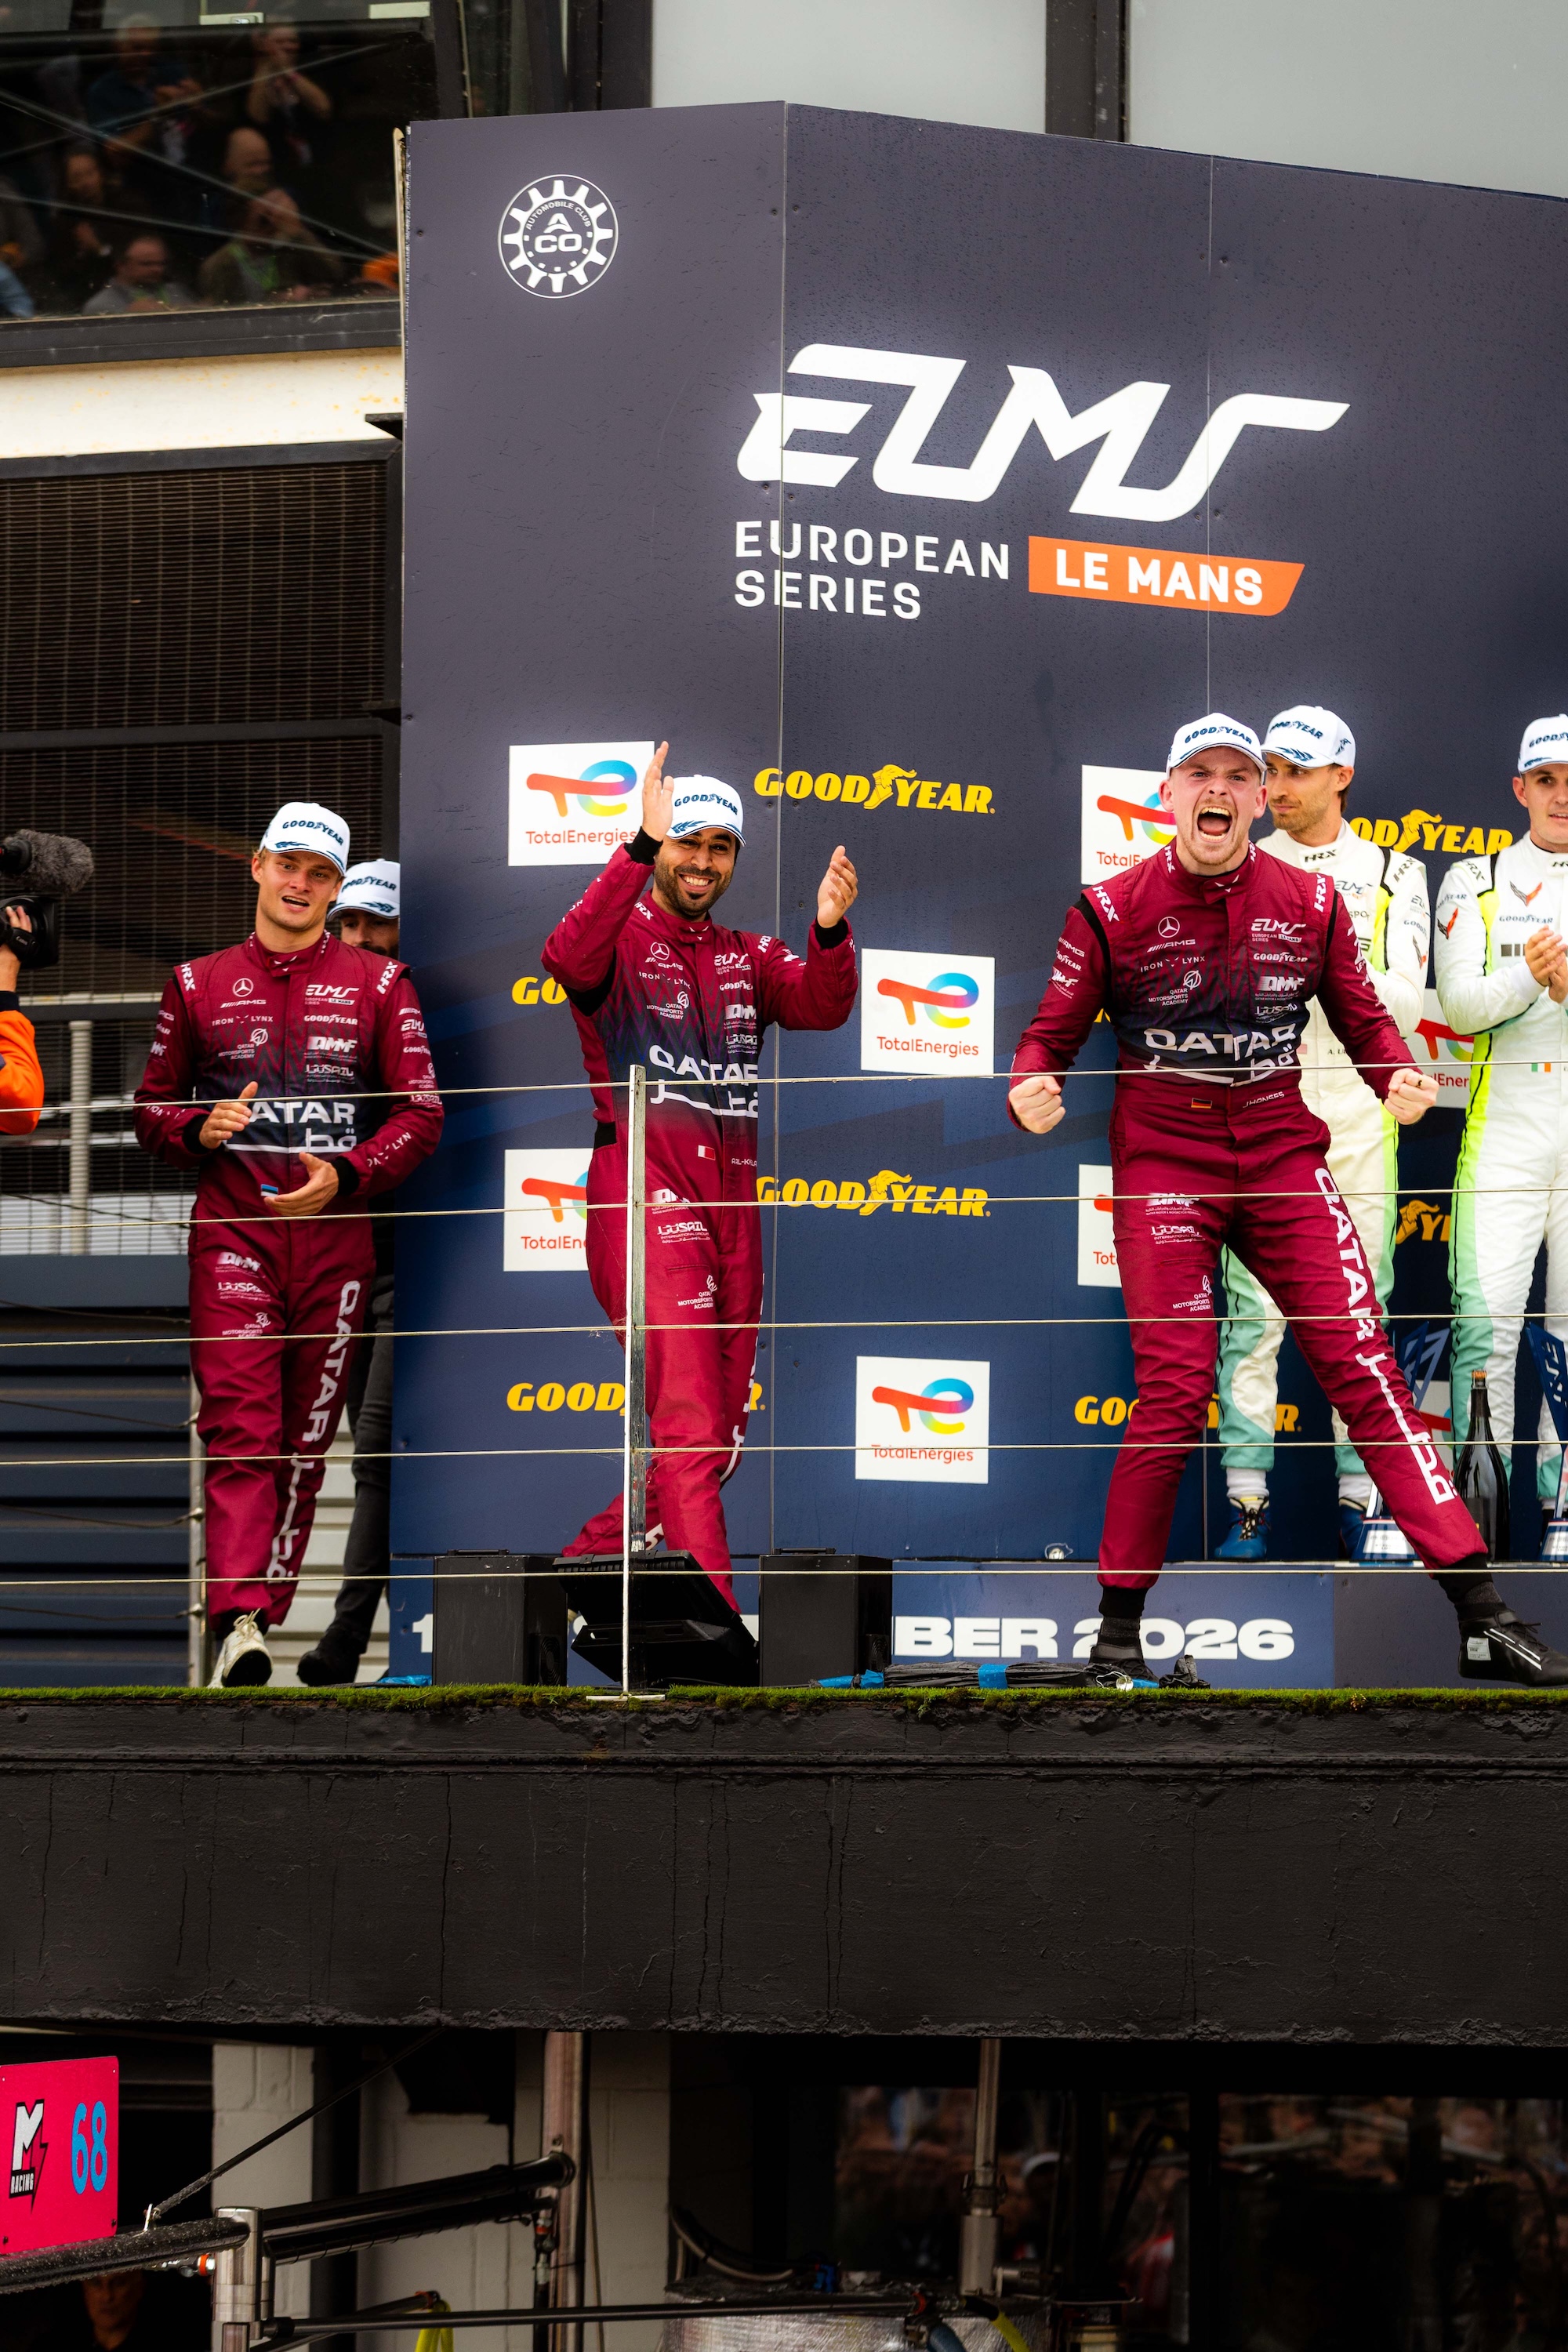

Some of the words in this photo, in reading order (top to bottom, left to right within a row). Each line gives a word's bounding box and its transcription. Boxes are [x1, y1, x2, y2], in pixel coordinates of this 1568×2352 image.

[525, 201, 575, 230] AUTOMOBILE
[575, 206, 592, 227] CLUB
[737, 343, 1350, 522] ELMS
[735, 521, 1011, 580] EUROPEAN
[1055, 547, 1109, 591] LE
[1127, 557, 1264, 607] MANS
[734, 569, 921, 621] SERIES
[1184, 725, 1253, 745] GOODYEAR
[1529, 731, 1568, 748] GOOD
[754, 764, 994, 815] GOODYEAR
[674, 793, 739, 815] GOODYEAR
[282, 820, 344, 846] GOODYEAR
[525, 828, 637, 847] TotalEnergies
[1348, 809, 1513, 855] ODYEAR
[1305, 849, 1338, 863] HRX
[1393, 858, 1417, 883] HRX
[1092, 885, 1120, 922] HRX
[1250, 918, 1306, 935] ELMS
[757, 935, 772, 953] HR
[1065, 941, 1085, 958] AMG
[1164, 939, 1196, 949] AMG
[658, 962, 684, 971] AMG
[1140, 961, 1163, 973] IRON
[1182, 956, 1206, 965] LYNX
[1254, 952, 1308, 963] GOODYEAR
[180, 963, 196, 992] HRX
[376, 961, 398, 994] HRX
[305, 984, 360, 998] ELMS
[1148, 993, 1189, 1004] MOTORSPORTS
[304, 1014, 358, 1025] GOODYEAR
[647, 1005, 684, 1015] MOTORSPORTS
[725, 1004, 757, 1020] QMM
[212, 1018, 234, 1026] IRON
[877, 1036, 979, 1058] TotalEnergies
[1144, 1023, 1296, 1061] QATAR
[249, 1101, 356, 1125] ATAR
[392, 1132, 413, 1150] LYN
[757, 1170, 987, 1217] GOODYEAR
[521, 1235, 587, 1250] TotalEn
[217, 1251, 261, 1272] QMM
[1314, 1167, 1377, 1342] QATAR
[677, 1297, 713, 1307] MOTORSPORTS
[1173, 1299, 1210, 1309] MOTORSPORTS
[302, 1279, 361, 1443] QATAR
[871, 1444, 974, 1465] TotalEnergies
[71, 2100, 108, 2194] 68
[10, 2172, 34, 2194] RACING
